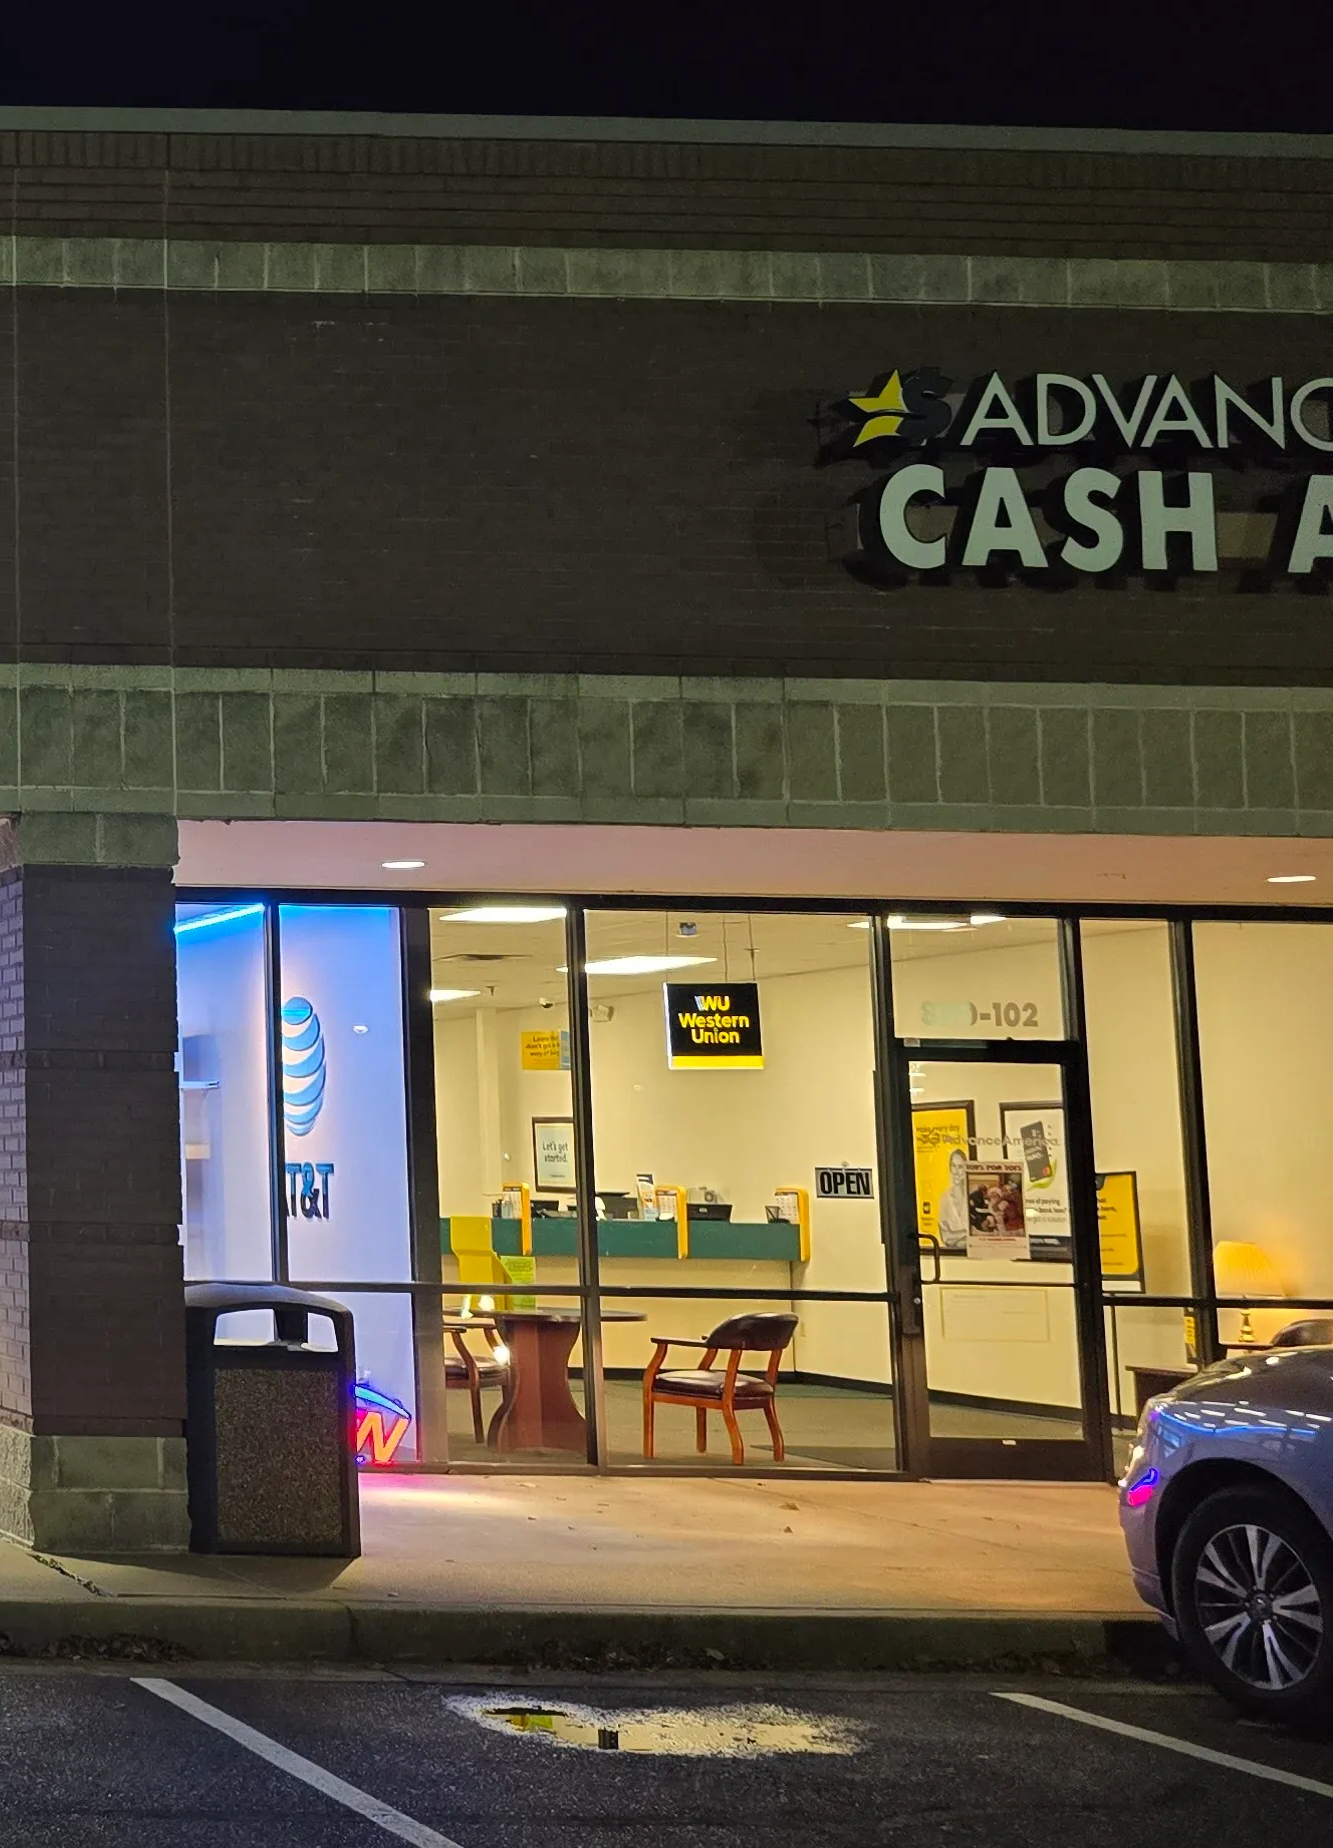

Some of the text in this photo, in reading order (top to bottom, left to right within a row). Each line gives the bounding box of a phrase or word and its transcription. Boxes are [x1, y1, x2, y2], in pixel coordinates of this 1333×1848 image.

[960, 371, 1333, 452] ADVANC
[879, 464, 1218, 573] CASH
[694, 995, 731, 1011] WU
[678, 1012, 750, 1028] Western
[691, 1027, 740, 1044] Union
[542, 1141, 569, 1153] Let's get
[285, 1162, 334, 1219] T&T
[820, 1171, 871, 1195] OPEN
